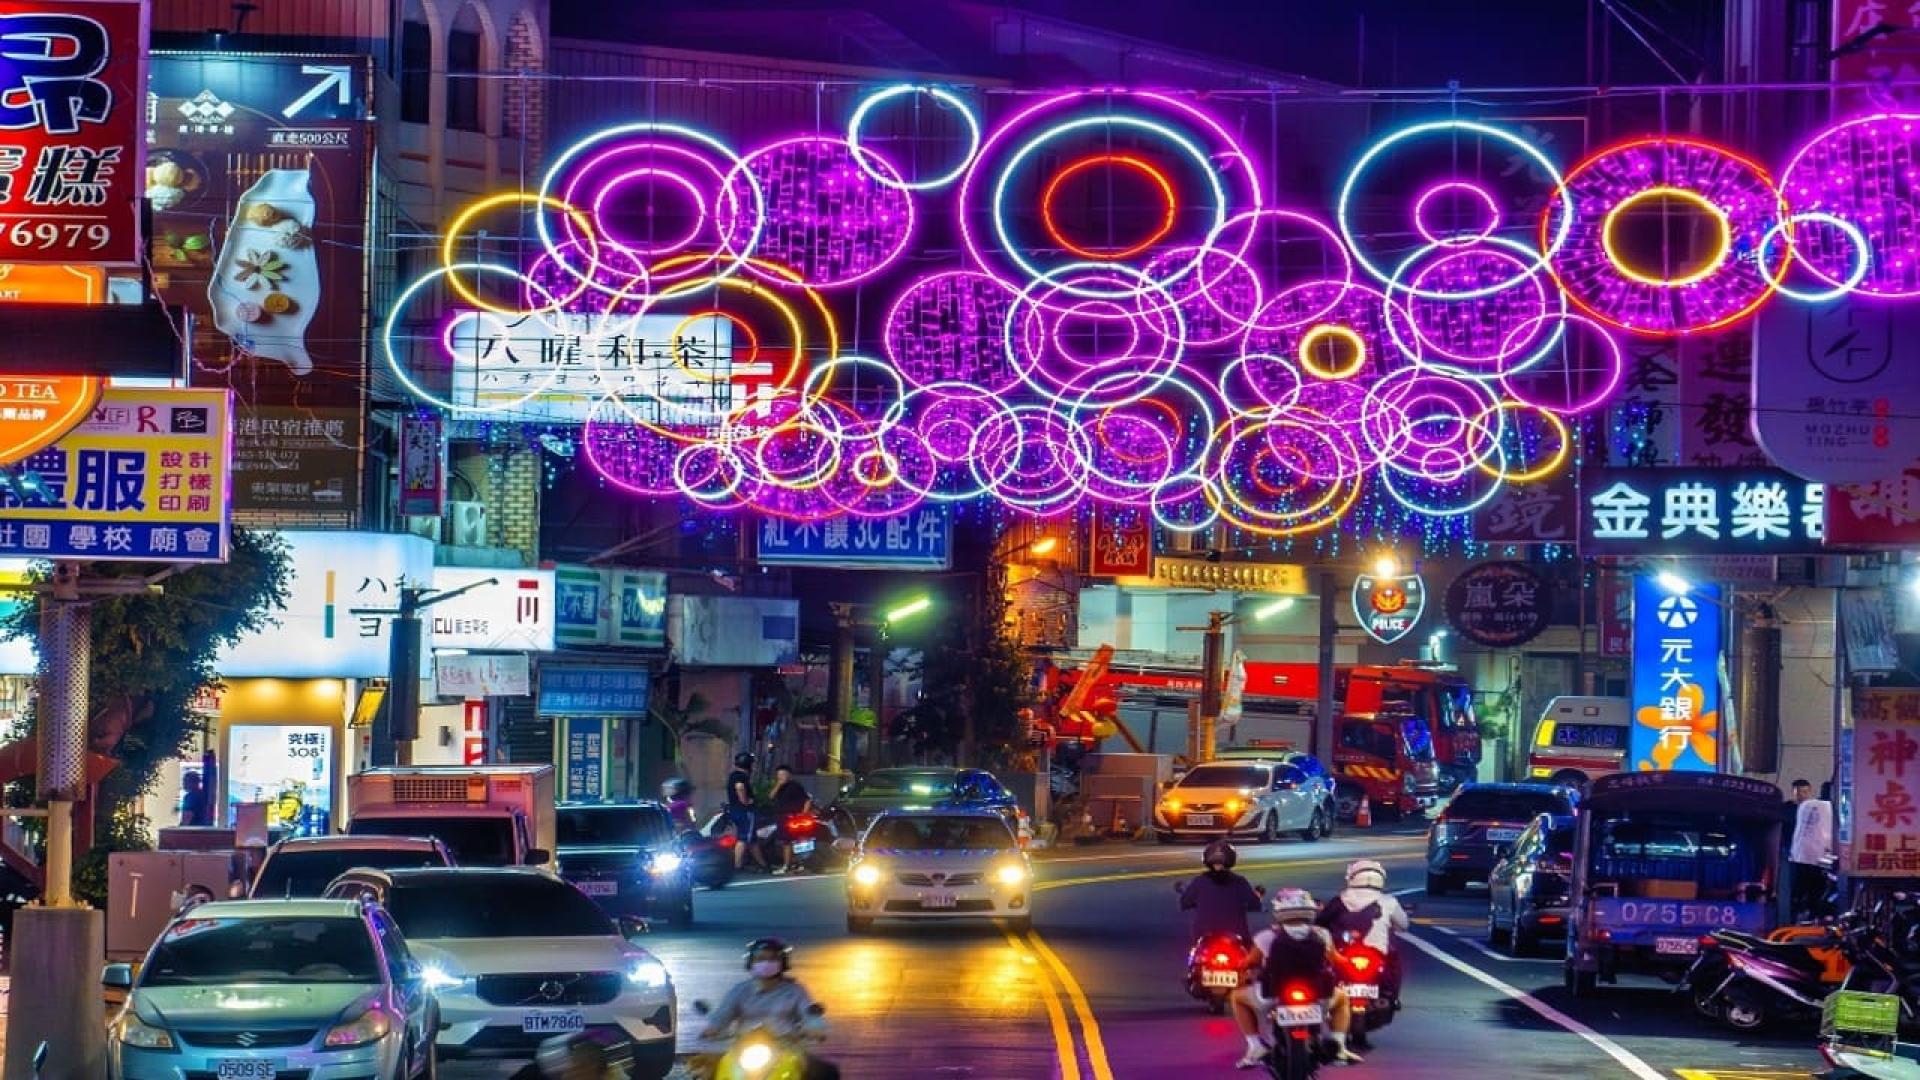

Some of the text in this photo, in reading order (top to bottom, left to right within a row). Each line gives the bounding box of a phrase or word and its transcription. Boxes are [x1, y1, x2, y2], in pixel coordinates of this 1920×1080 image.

[17, 385, 57, 400] TEA
[233, 418, 345, 436] 港民宿推薦
[158, 495, 211, 511] 印刷
[69, 525, 132, 551] 學校
[432, 617, 453, 634] CU
[1372, 617, 1406, 631] POLICE
[1659, 638, 1693, 752] 元大銀行
[288, 732, 320, 745] 究極
[288, 747, 320, 758] 308
